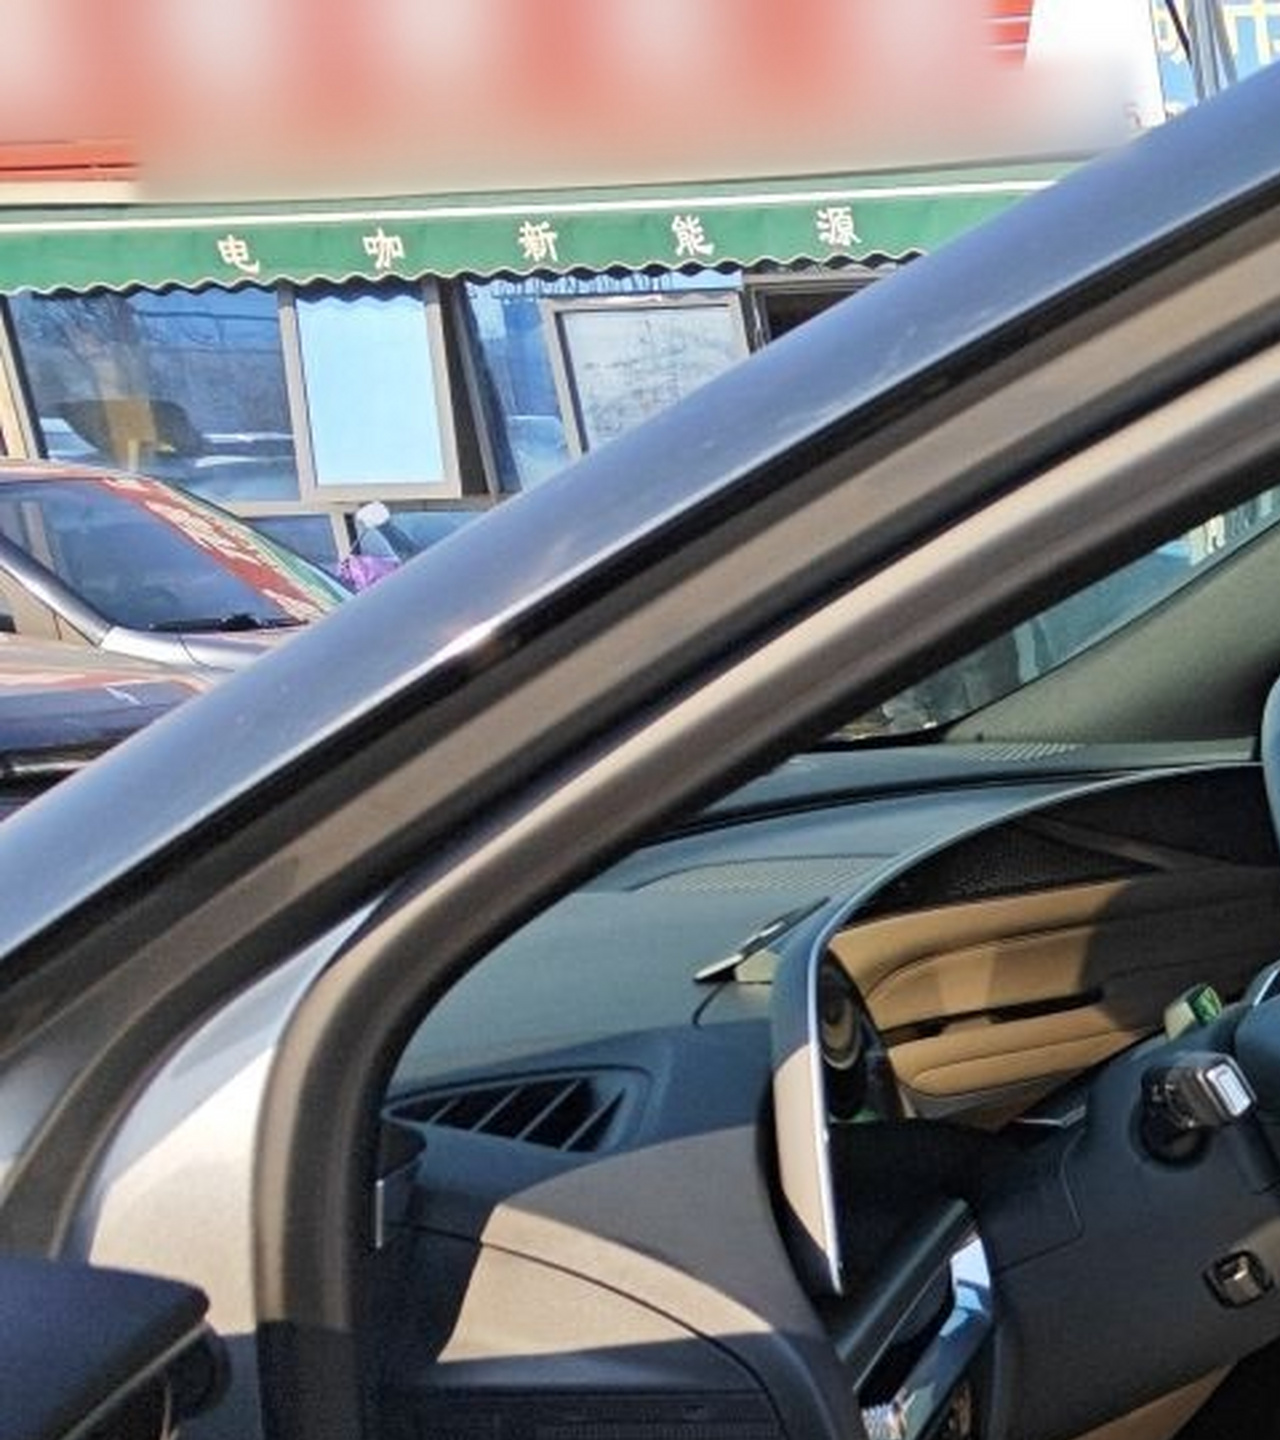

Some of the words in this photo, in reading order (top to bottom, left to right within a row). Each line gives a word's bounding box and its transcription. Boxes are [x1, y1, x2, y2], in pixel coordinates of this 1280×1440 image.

[216, 205, 862, 275] 电咖新能源
